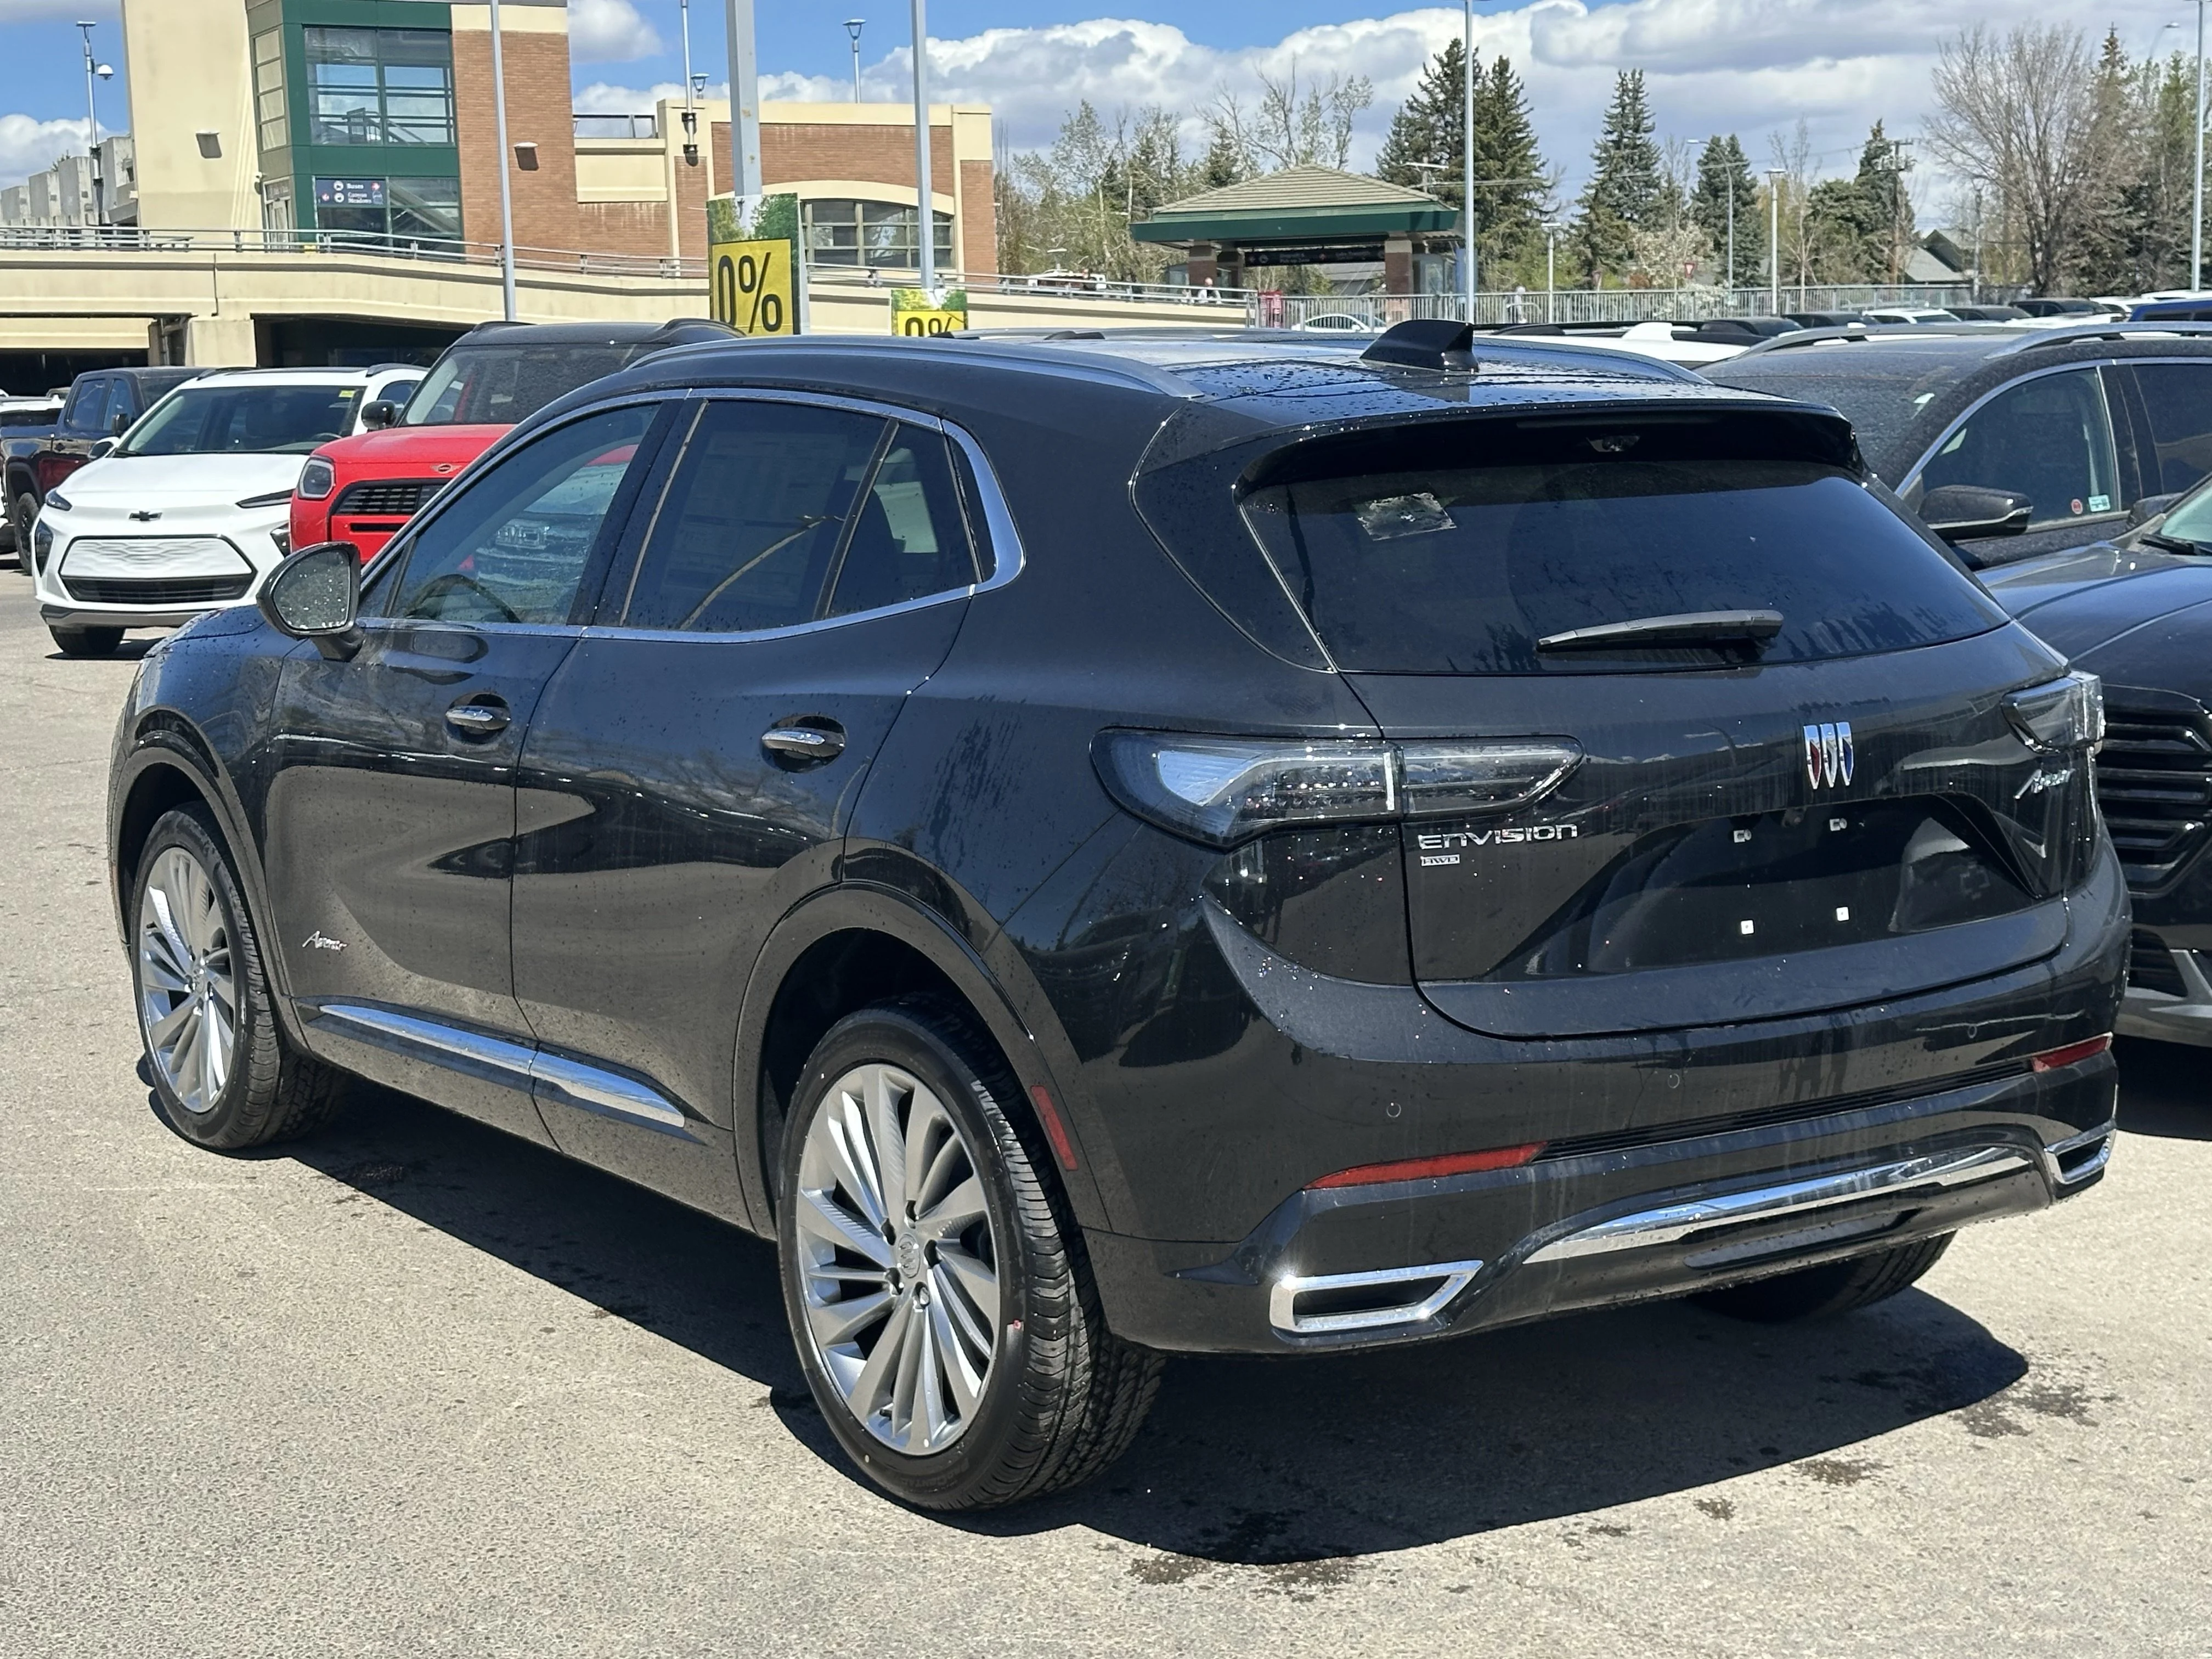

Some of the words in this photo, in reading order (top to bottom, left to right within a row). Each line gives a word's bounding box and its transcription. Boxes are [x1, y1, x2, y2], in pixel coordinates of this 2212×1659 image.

[718, 252, 783, 333] 0%
[1418, 824, 1578, 849] ENVISION
[1422, 855, 1459, 866] AWD
